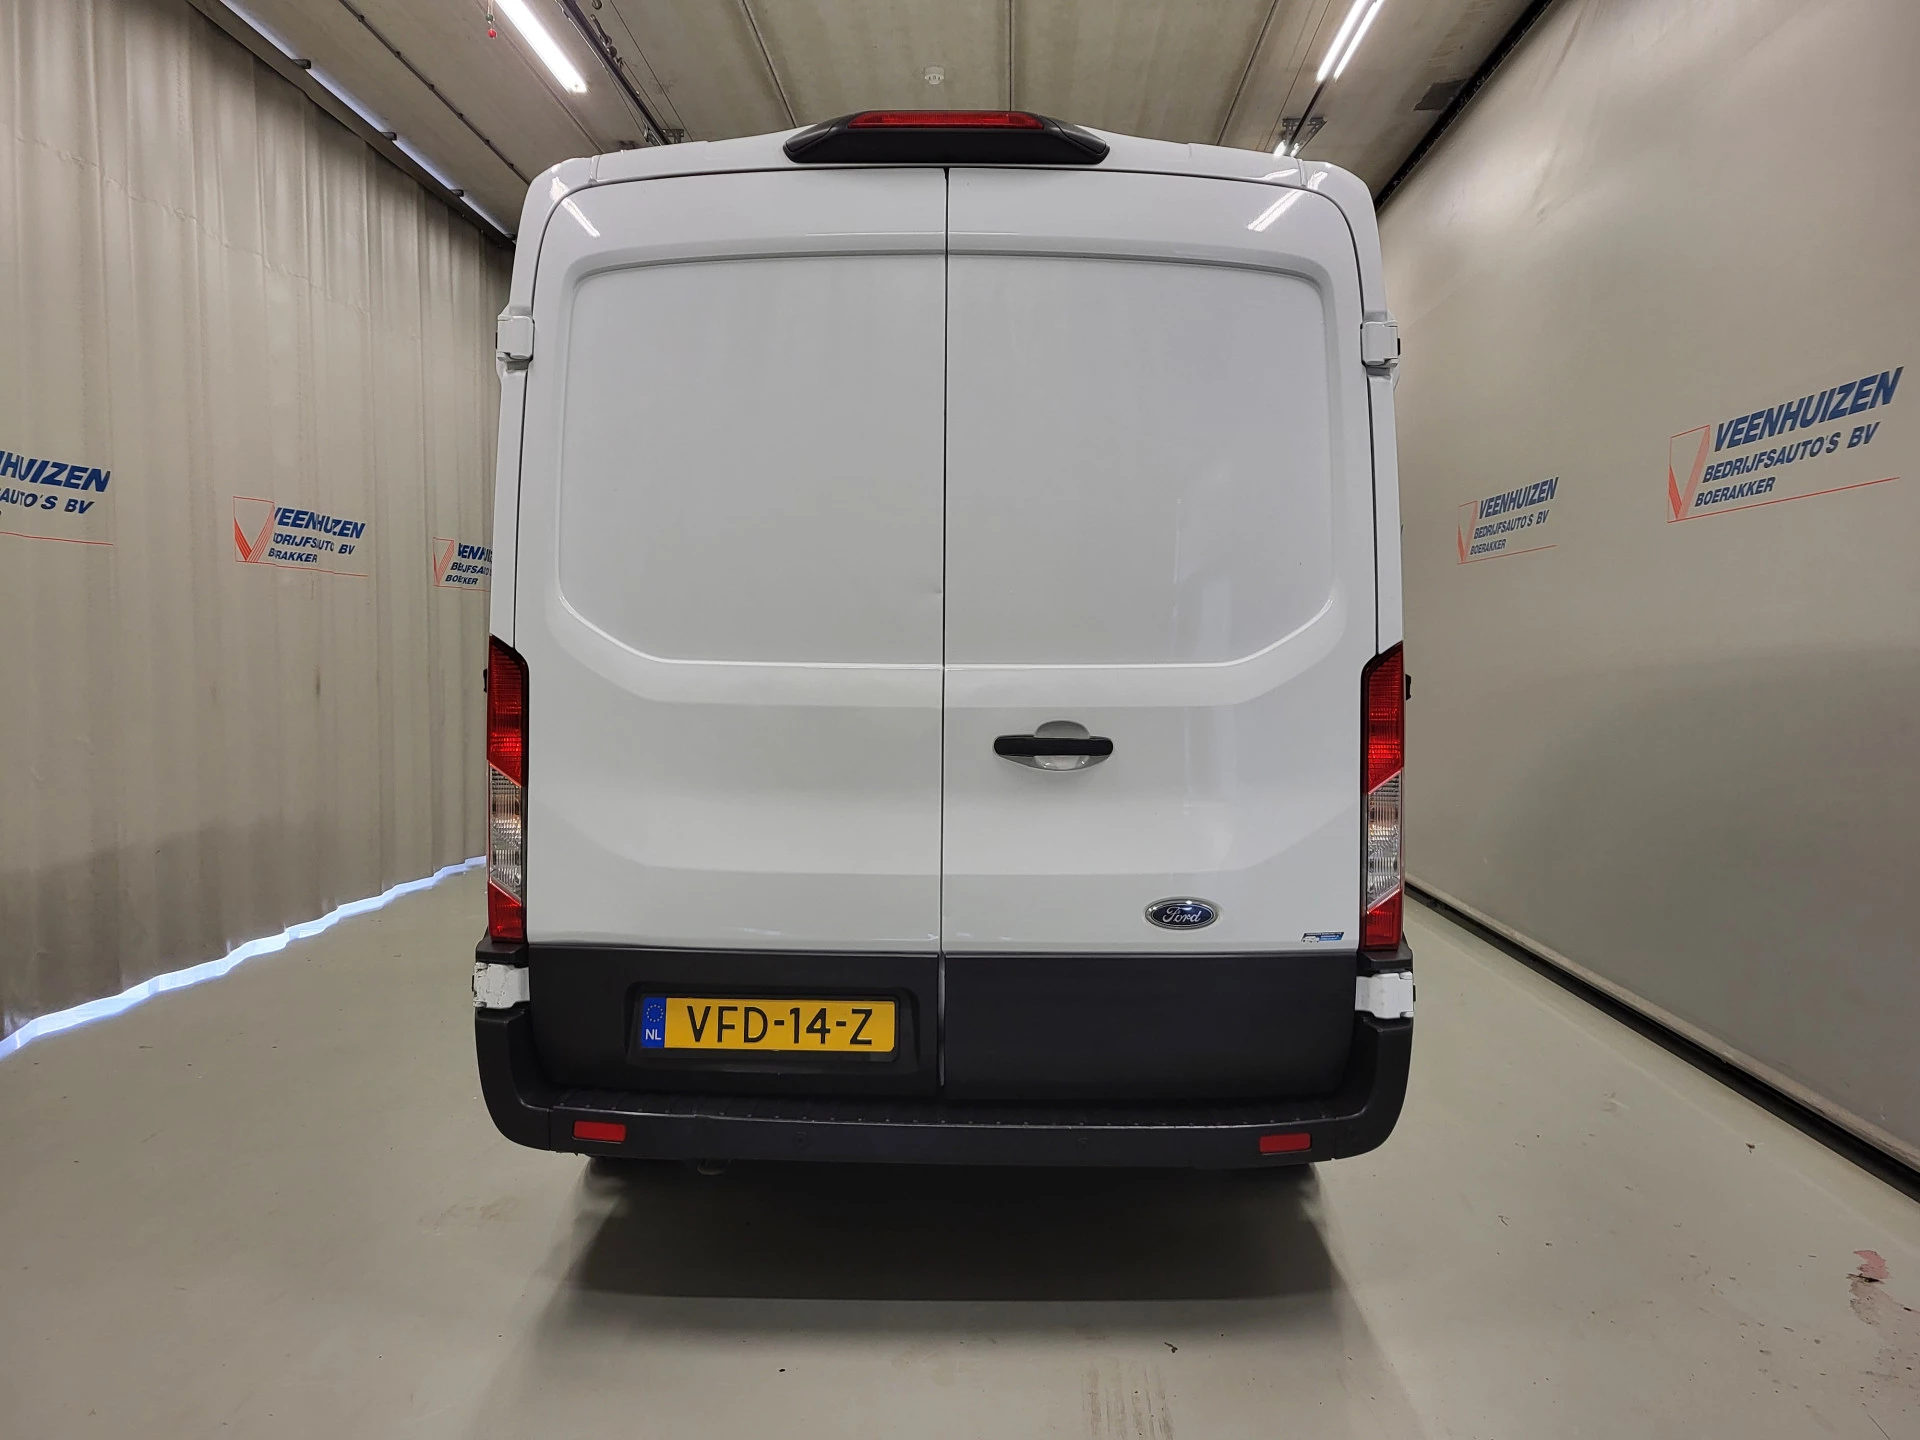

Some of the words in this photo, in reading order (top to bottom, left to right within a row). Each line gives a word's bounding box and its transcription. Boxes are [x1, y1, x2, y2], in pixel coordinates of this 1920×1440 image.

[1714, 366, 1905, 452] VEENHUIZEN
[1702, 432, 1842, 483] BEDRIJFSAUTO'S
[1847, 421, 1881, 449] BV
[0, 487, 58, 510] AUTO'S
[64, 498, 95, 514] BV
[1479, 476, 1559, 519] VEENHUIZEN
[1694, 476, 1776, 507] BOERAKKER
[1536, 509, 1549, 525] BV
[338, 543, 356, 555] BV
[1469, 538, 1507, 555] BOERAKKER
[1162, 906, 1202, 923] Ford
[645, 1029, 661, 1040] NL
[686, 1005, 873, 1046] VFD-14-Z
